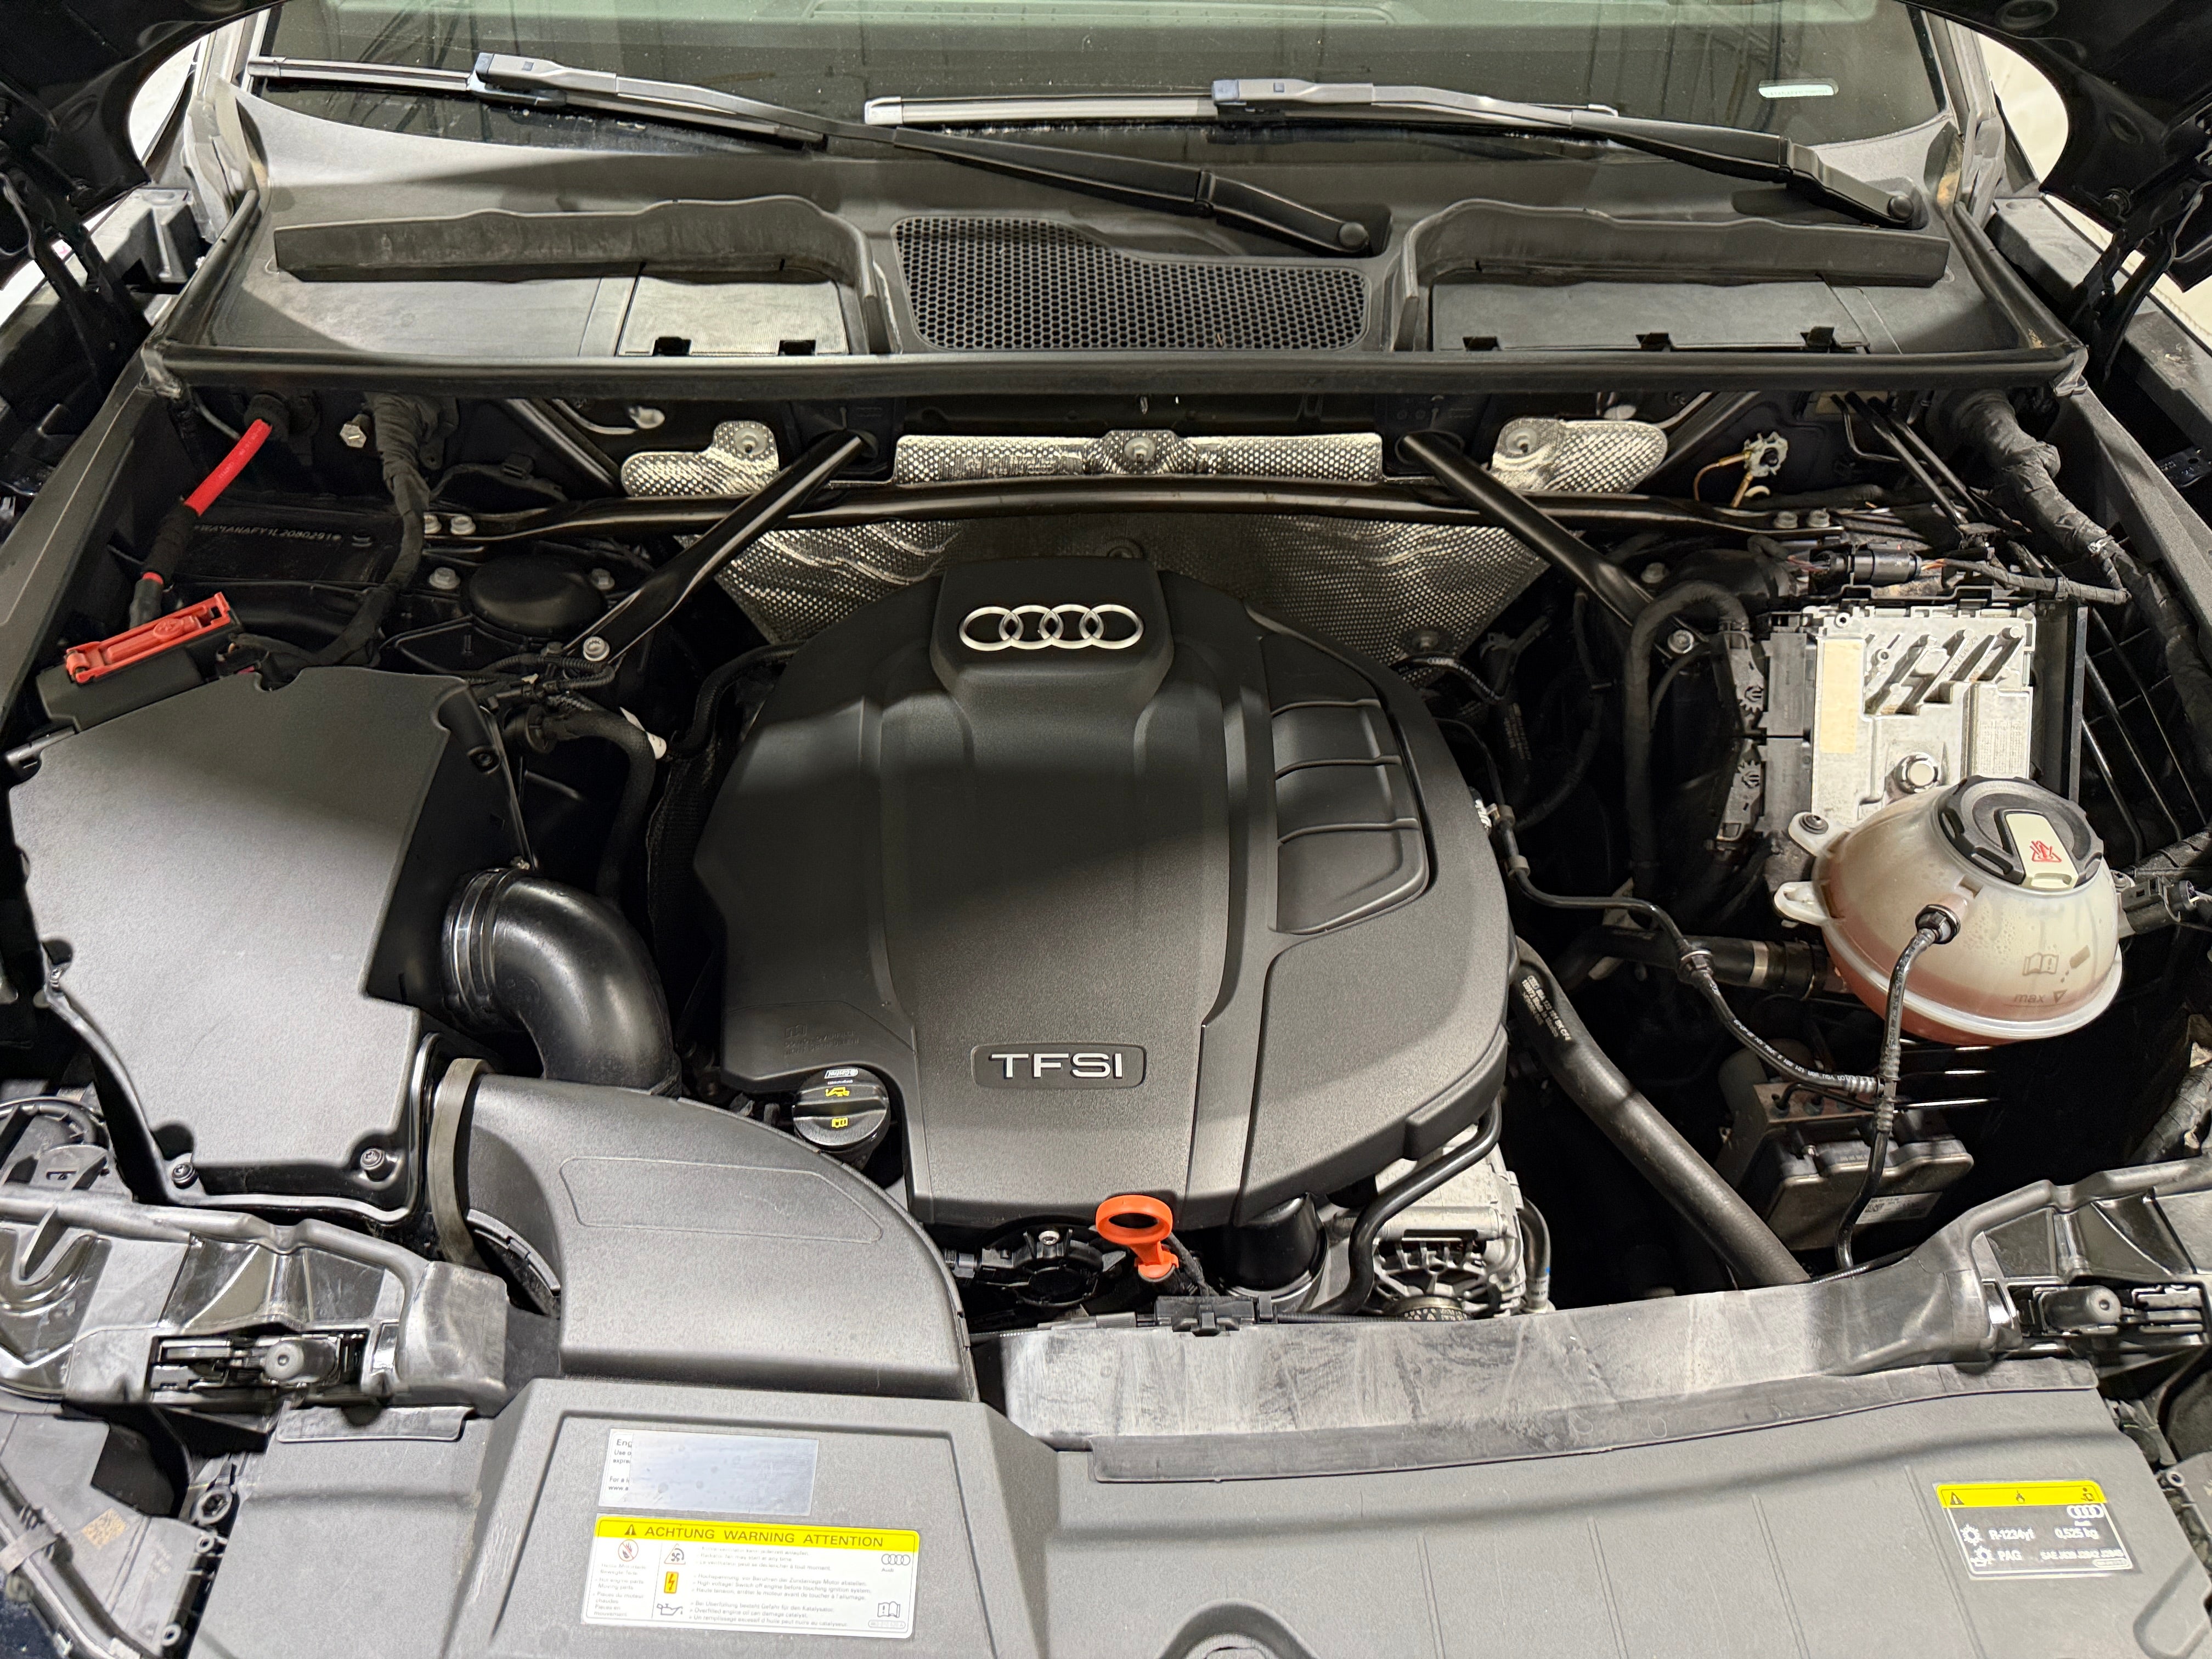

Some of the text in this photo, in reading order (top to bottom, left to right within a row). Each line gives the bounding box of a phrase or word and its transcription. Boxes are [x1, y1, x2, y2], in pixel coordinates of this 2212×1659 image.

[2014, 994, 2046, 1003] max
[991, 1052, 1122, 1079] TFSI
[644, 1525, 883, 1548] ACHTUNG WARNING ATTENTION
[1988, 1527, 2100, 1541] R-1234yf 0,525 kg
[1997, 1550, 2023, 1561] PAG
